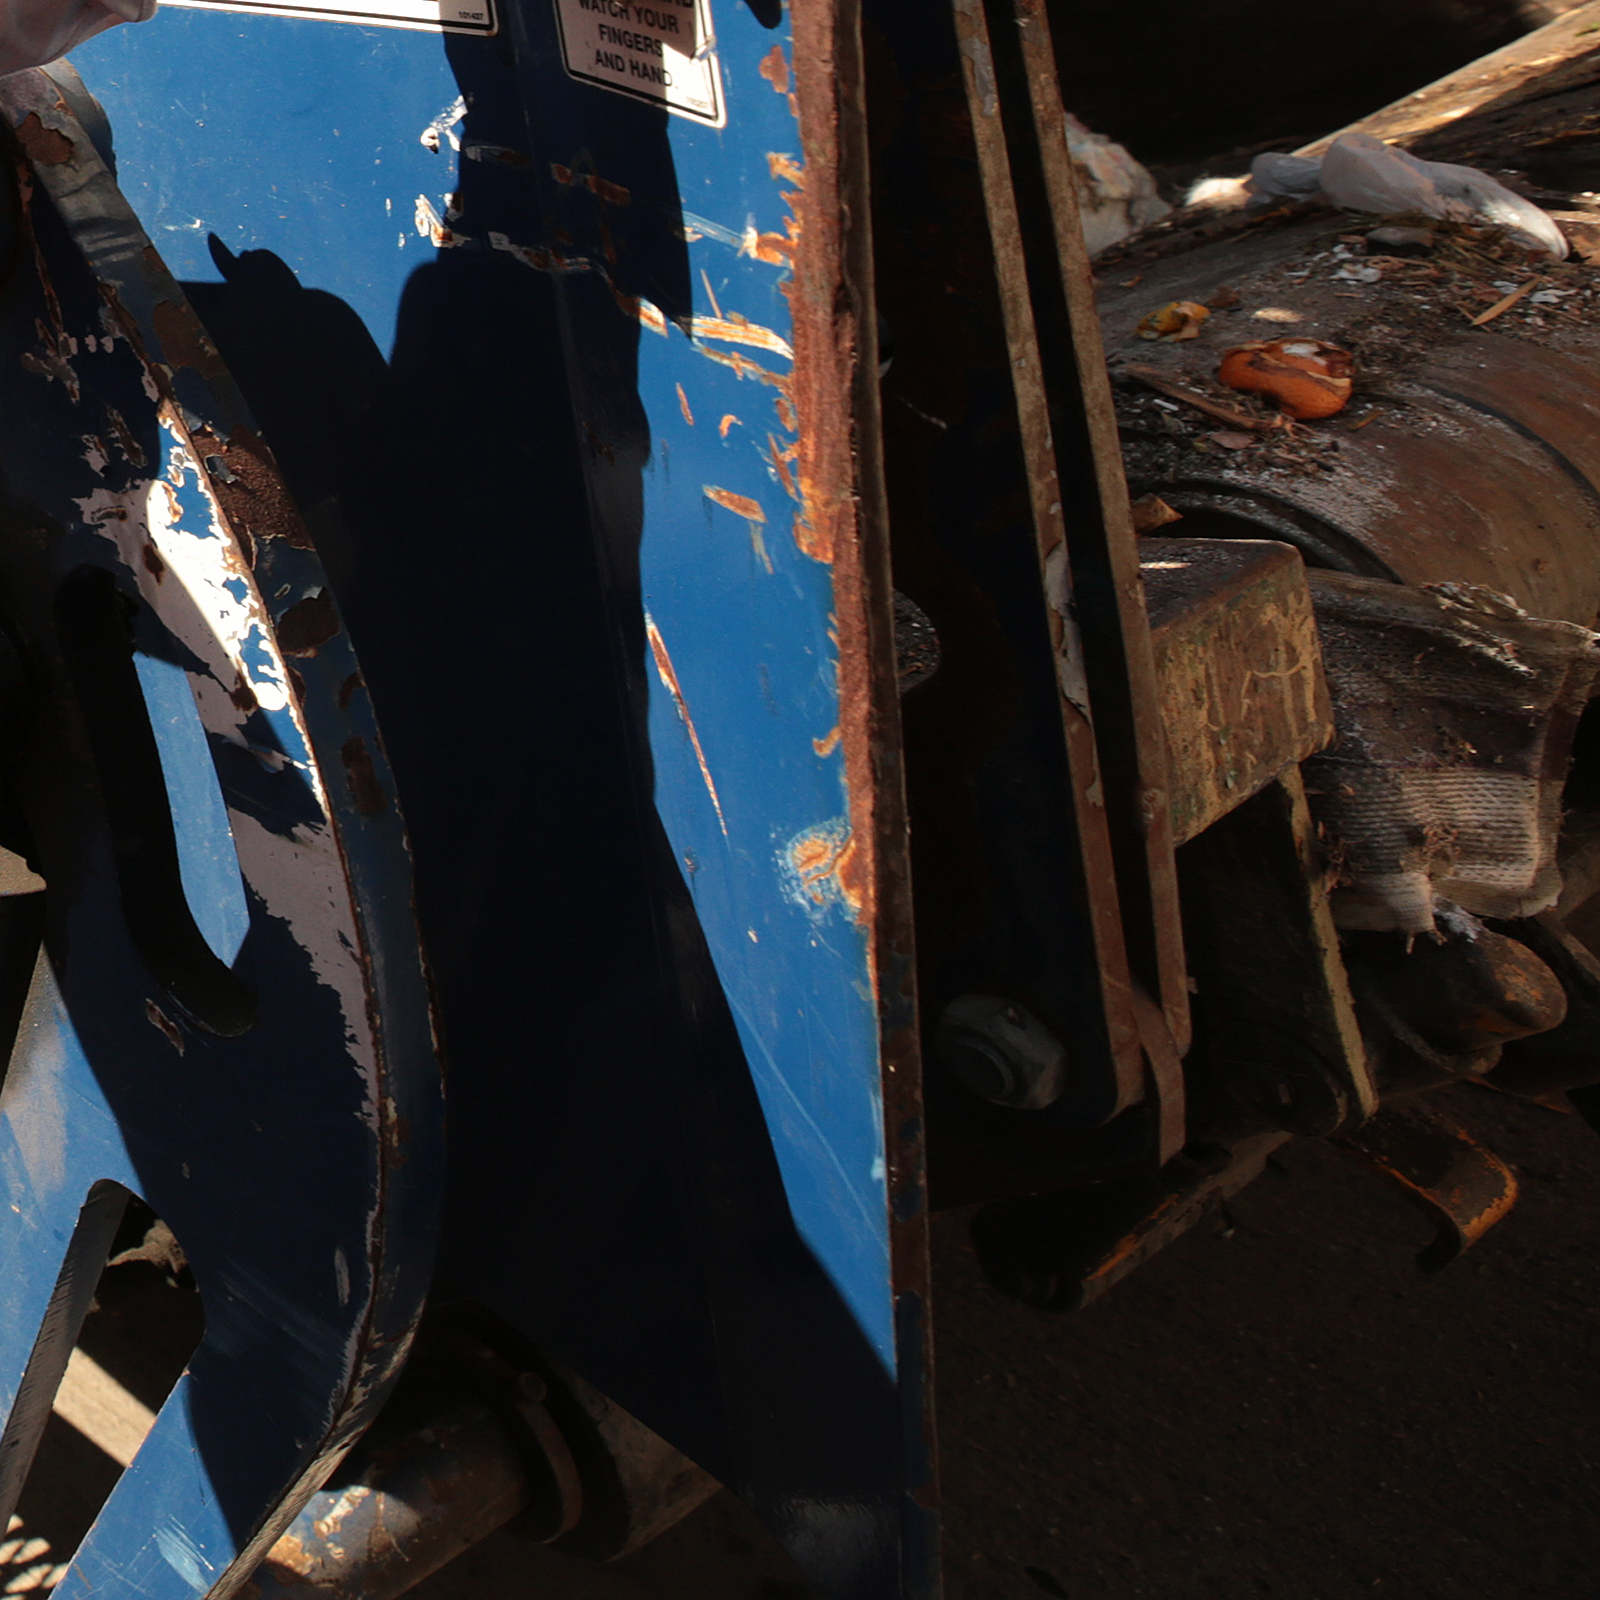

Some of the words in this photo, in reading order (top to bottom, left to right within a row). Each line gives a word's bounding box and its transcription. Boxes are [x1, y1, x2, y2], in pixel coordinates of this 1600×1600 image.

[633, 5, 679, 34] YOUR
[598, 23, 663, 58] FINGERS
[595, 50, 626, 73] AND
